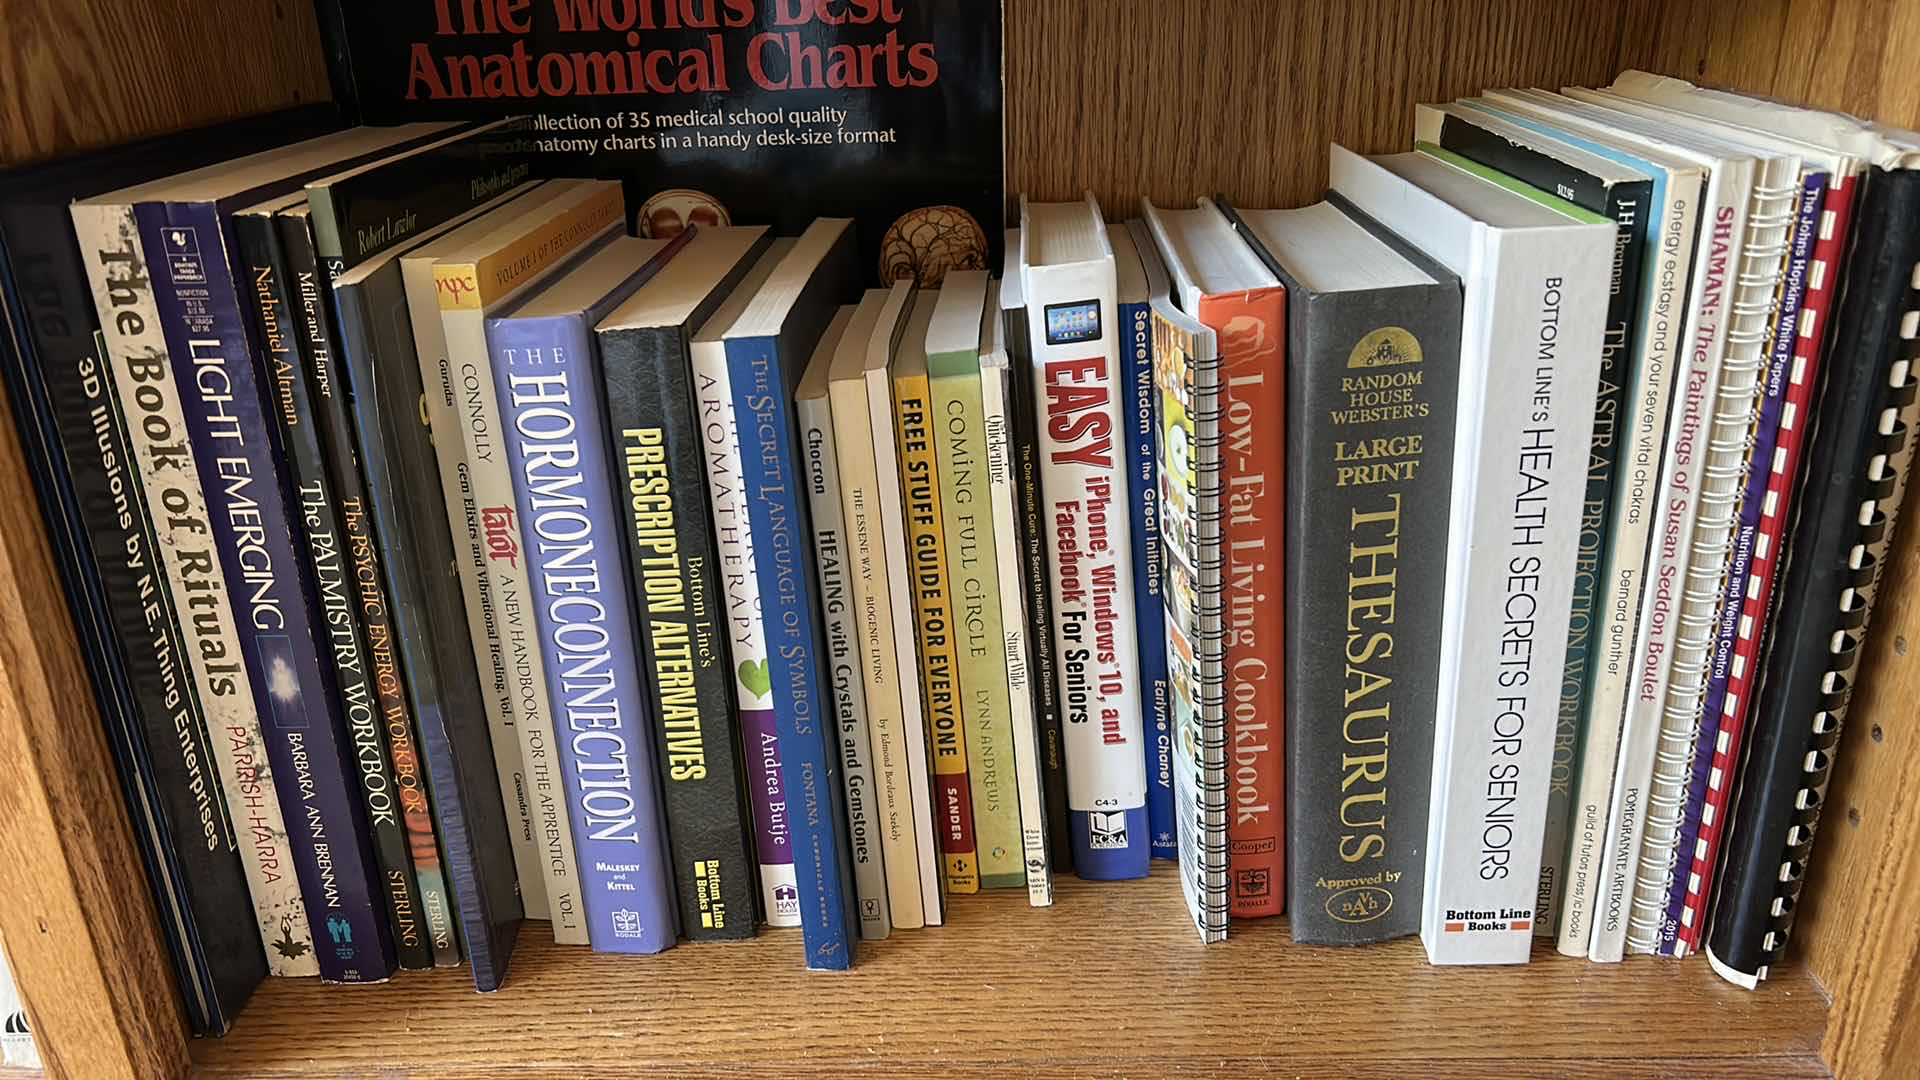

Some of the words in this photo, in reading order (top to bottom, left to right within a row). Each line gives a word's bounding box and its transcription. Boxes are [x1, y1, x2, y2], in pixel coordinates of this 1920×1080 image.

[404, 32, 731, 100] Anatomical
[746, 28, 940, 91] Charts
[603, 133, 656, 151] charts
[697, 130, 751, 150] handy
[757, 128, 832, 146] desk-size
[838, 128, 896, 145] format
[629, 111, 650, 128] 35
[656, 109, 723, 128] medical
[728, 107, 784, 127] school
[788, 106, 848, 128] quality
[1665, 200, 1686, 257] energy
[1794, 216, 1815, 258] Johns
[98, 239, 150, 337] The
[1609, 233, 1632, 295] Brennan
[1701, 205, 1734, 316] SHAMAN:
[1784, 259, 1808, 313] Hopkins
[436, 275, 476, 305] npc
[1654, 259, 1676, 323] ecstasy
[253, 266, 289, 353] Nathaniel
[273, 357, 298, 426] Altman
[298, 271, 317, 316] Miller
[313, 349, 331, 399] Harper
[1135, 310, 1150, 366] Secret
[1536, 277, 1563, 360] BOTTOM
[1693, 324, 1715, 364] The
[1776, 313, 1797, 352] White
[438, 359, 453, 407] Gurudas
[503, 346, 567, 365] THE
[1341, 370, 1424, 393] RANDOM
[1768, 352, 1788, 398] Papers
[126, 345, 192, 472] Book
[188, 338, 248, 447] LIGHT
[461, 363, 494, 463] CONNOLLY
[1044, 355, 1114, 470] EASY
[1136, 368, 1151, 435] Wisdom
[1331, 403, 1431, 425] WEBSTER'S
[1350, 388, 1414, 408] HOUSE
[1532, 366, 1554, 423] LINE'S
[1641, 390, 1659, 430] seven
[1674, 370, 1709, 467] Paintings
[745, 394, 782, 481] SECRET
[901, 398, 927, 453] FREE
[947, 400, 974, 505] COMING
[987, 413, 1008, 484] Quickening
[1228, 371, 1265, 528] Low-Fat
[1333, 435, 1424, 462] LARGE
[1636, 433, 1653, 466] vital
[457, 462, 470, 493] Gem
[807, 427, 825, 494] Chocron
[1023, 463, 1036, 514] One-Minute
[1141, 461, 1151, 481] the
[1335, 460, 1421, 487] PRINT
[1511, 429, 1555, 546] HEALTH
[161, 487, 208, 538] of
[299, 480, 322, 528] The
[343, 496, 362, 532] The
[463, 497, 477, 539] Elixirs
[622, 427, 686, 615] PRESCRIPTION
[698, 373, 753, 648] AROMATHERAPY
[853, 487, 864, 510] THE
[907, 461, 935, 526] STUFF
[1144, 488, 1158, 532] Great
[1628, 469, 1649, 525] chakras
[217, 456, 284, 630] EMERGING
[758, 483, 796, 606] LANGUAGE
[856, 513, 869, 554] ESSENE
[958, 513, 978, 569] FULL
[1663, 498, 1688, 559] Susan
[1733, 525, 1755, 574] Nutrition
[350, 534, 382, 617] PSYCHIC
[687, 557, 706, 618] Bottom
[916, 533, 942, 600] GUIDE
[1032, 555, 1042, 582] Secret
[1146, 536, 1160, 596] Initiates
[1221, 534, 1266, 649] Living
[79, 356, 101, 400] 3D
[90, 405, 133, 531] Illusions
[174, 707, 220, 851] Enterprises
[175, 548, 244, 698] Rituals
[310, 529, 362, 675] PALMISTRY
[475, 569, 496, 637] Vibrational
[503, 588, 522, 625] NEW
[864, 596, 880, 645] BIOGENIC
[963, 577, 987, 658] CIRCLE
[1035, 592, 1046, 624] Healing
[1498, 556, 1542, 688] SECRETS
[1615, 569, 1635, 622] bernard
[1649, 564, 1677, 636] Seddon
[1719, 598, 1740, 641] Weight
[694, 620, 715, 669] Line's
[923, 606, 946, 647] FOR
[1007, 631, 1022, 663] Stuart
[1039, 625, 1050, 659] Virtually
[1061, 611, 1087, 644] For
[1606, 624, 1624, 676] gunther
[368, 623, 399, 697] ENERGY
[511, 630, 540, 721] HANDBOOK
[871, 646, 884, 684] LIVING
[1010, 660, 1027, 691] Wilde
[1064, 648, 1093, 725] Seniors
[1338, 492, 1401, 864] THESAURUS
[1639, 645, 1665, 702] Boulet
[1712, 640, 1733, 680] Control
[649, 619, 707, 782] ALTERNATIVES
[778, 644, 813, 735] SYMBOLS
[818, 530, 845, 615] HEALING
[834, 664, 857, 733] Crystals
[848, 774, 869, 864] Gemstones
[928, 654, 958, 757] EVERYONE
[976, 689, 993, 731] LYNN
[1154, 679, 1168, 732] Earlyne
[343, 681, 396, 827] WORKBOOK
[881, 732, 893, 768] Edmond
[1100, 707, 1128, 745] and
[1232, 656, 1270, 827] Cookbook
[1491, 696, 1527, 756] FOR
[1550, 657, 1585, 798] WORKBOOK
[287, 732, 315, 801] BARBARA
[383, 704, 423, 816] WORKBOOK
[534, 761, 552, 791] THE
[760, 732, 784, 796] Andrea
[979, 735, 1001, 813] ANDREWS
[1157, 735, 1170, 788] Chaney
[226, 724, 282, 885] PARRISH-HARRA
[305, 805, 326, 838] ANN
[513, 772, 527, 817] Cassandra
[801, 761, 820, 827] FONTANA
[947, 787, 963, 841] SANDER
[540, 792, 567, 877] APPRENTICE
[768, 800, 790, 846] Butje
[1480, 764, 1521, 881] SENIORS
[1618, 787, 1639, 876] POMEGRANATE
[314, 843, 341, 908] BRENNAN
[596, 862, 640, 872] MALESKEY
[607, 881, 636, 891] KITTEL
[696, 879, 709, 911] Books
[706, 859, 721, 901] Bottom
[1315, 872, 1383, 889] Approved
[1385, 870, 1403, 883] by
[388, 870, 419, 948] STERLING
[425, 890, 449, 950] STERLING
[712, 902, 725, 929] Line
[776, 901, 798, 909] HAY
[1445, 909, 1497, 921] Bottom
[1500, 908, 1531, 919] Line
[1468, 921, 1507, 931] Books
[1664, 919, 1677, 942] 2015
